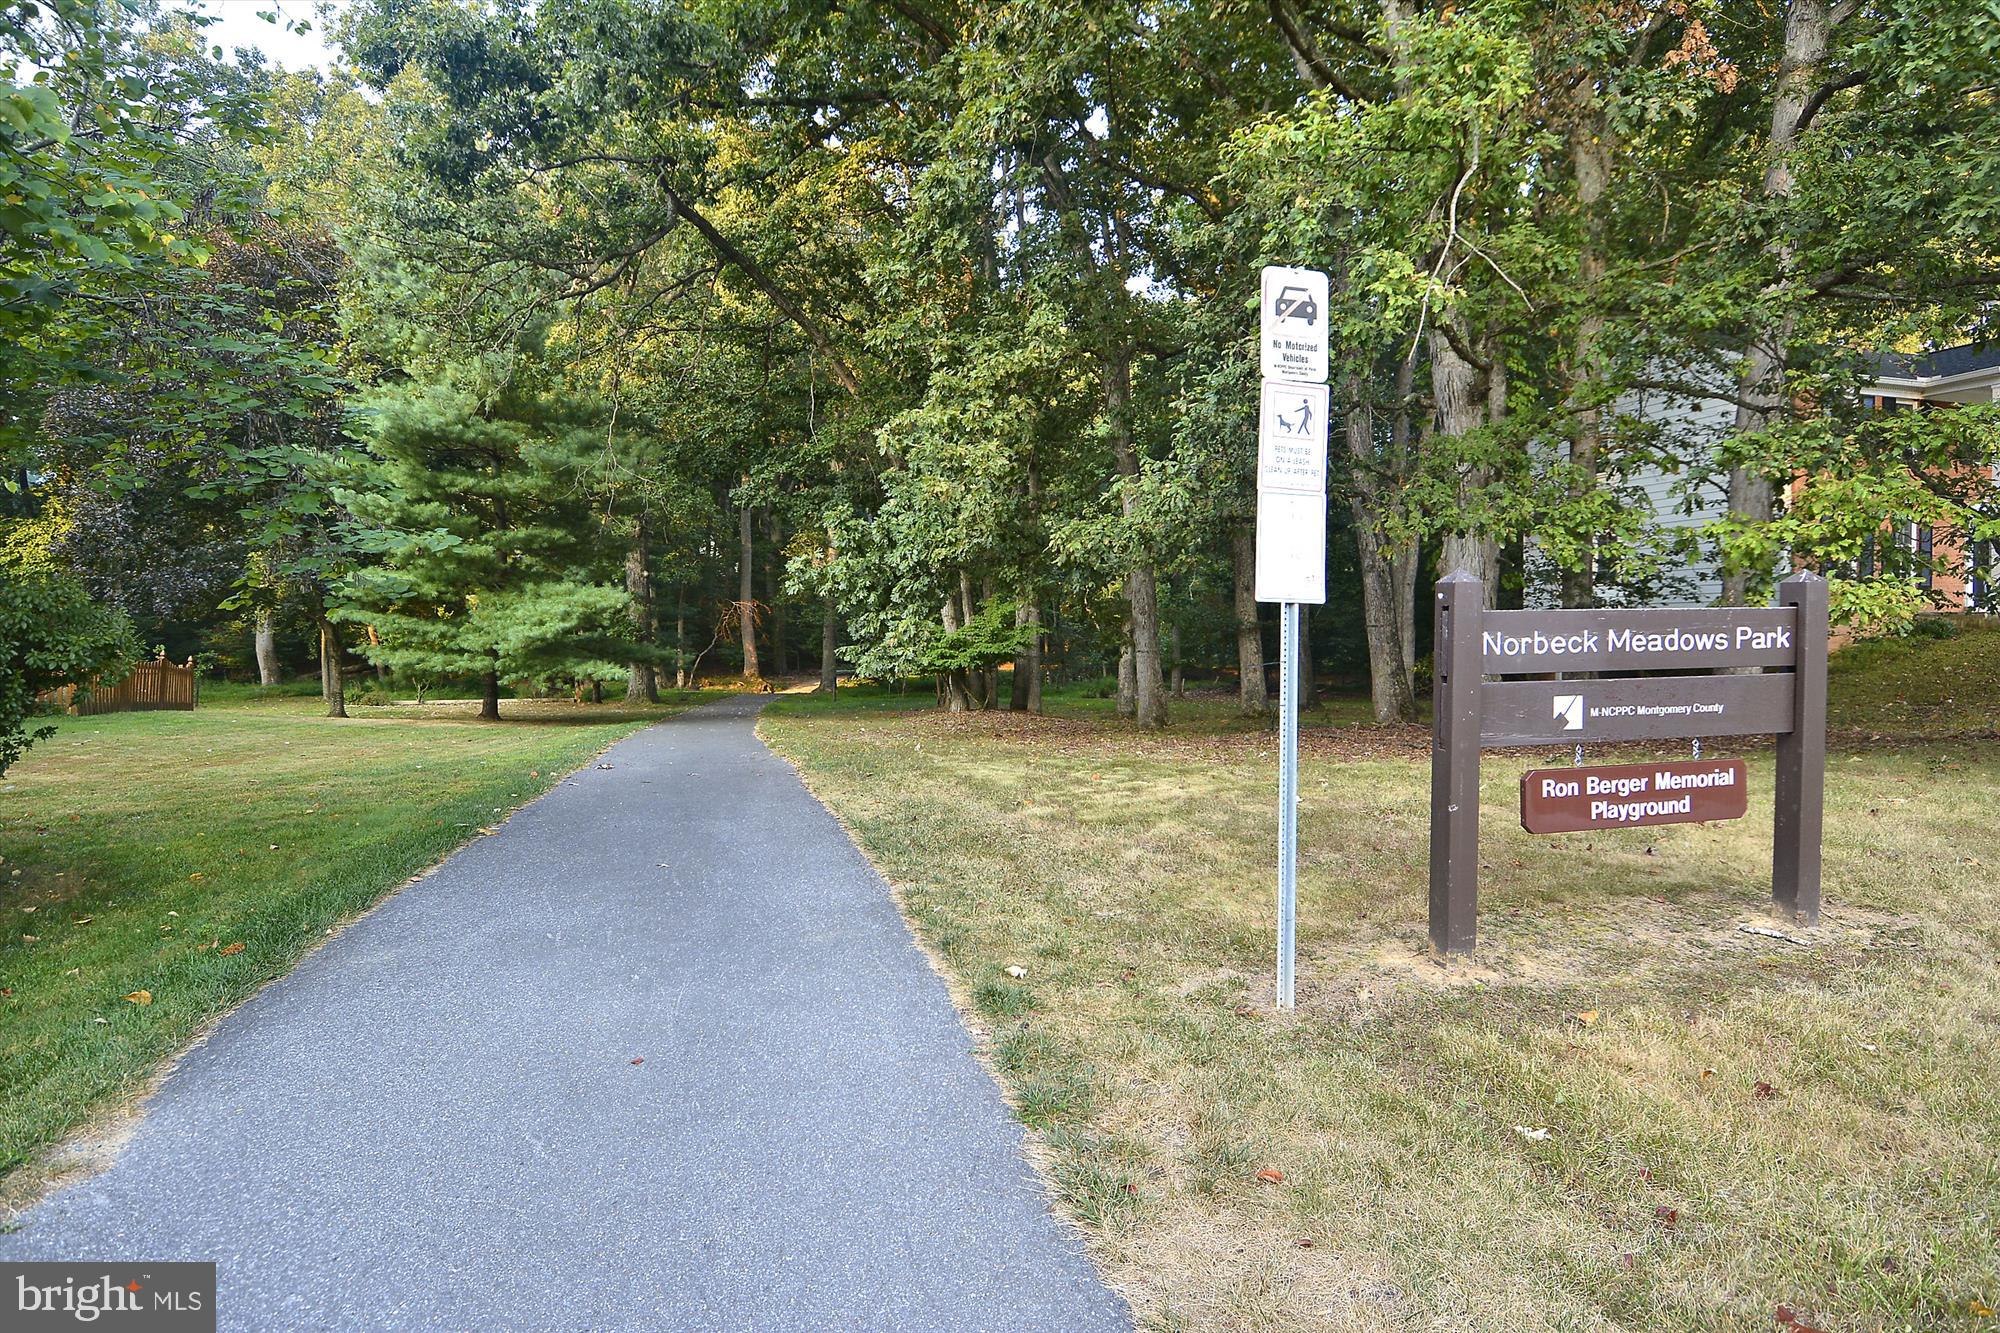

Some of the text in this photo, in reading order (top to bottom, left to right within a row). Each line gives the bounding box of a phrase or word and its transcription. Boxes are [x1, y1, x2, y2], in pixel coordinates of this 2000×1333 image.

[1273, 339, 1318, 352] No Motorized
[1282, 353, 1309, 363] Vehicles
[1482, 626, 1790, 656] Norbeck Meadows Park
[1590, 703, 1724, 718] M-NCPPC Montgomery County
[1541, 768, 1735, 798] Ron Berger Memorial
[1591, 795, 1691, 821] Playground
